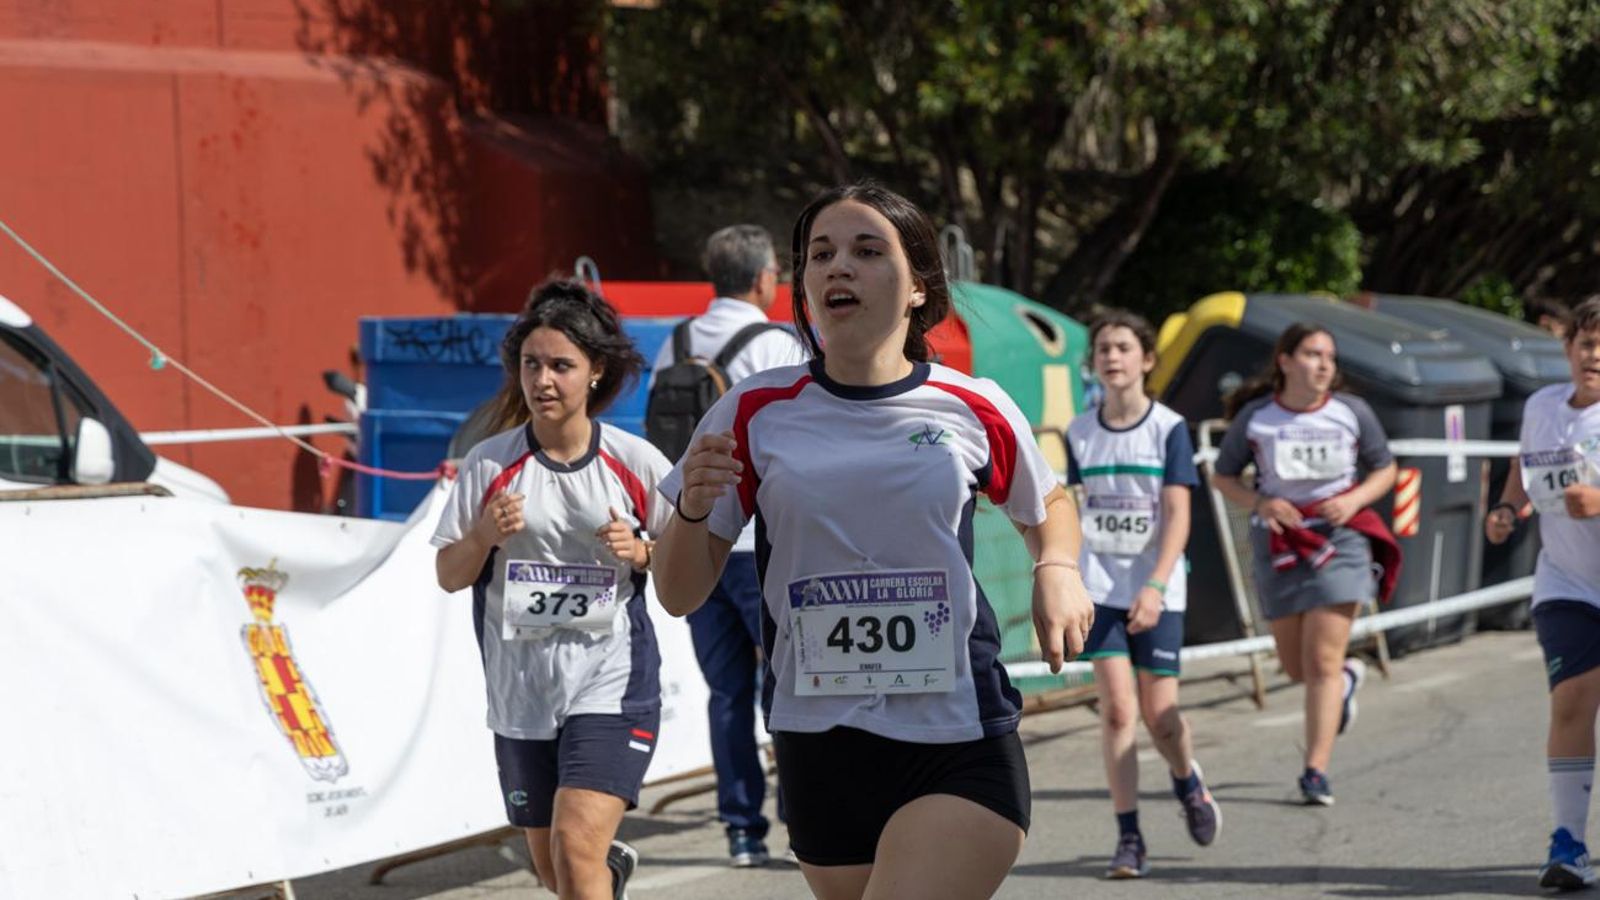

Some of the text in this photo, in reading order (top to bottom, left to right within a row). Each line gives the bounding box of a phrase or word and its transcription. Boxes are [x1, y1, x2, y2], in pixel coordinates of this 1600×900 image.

[1094, 515, 1148, 534] 1045
[870, 575, 944, 588] CARRERA ESCOLAR
[877, 587, 934, 600] LA GLORIA
[527, 591, 589, 617] 373
[827, 615, 916, 654] 430
